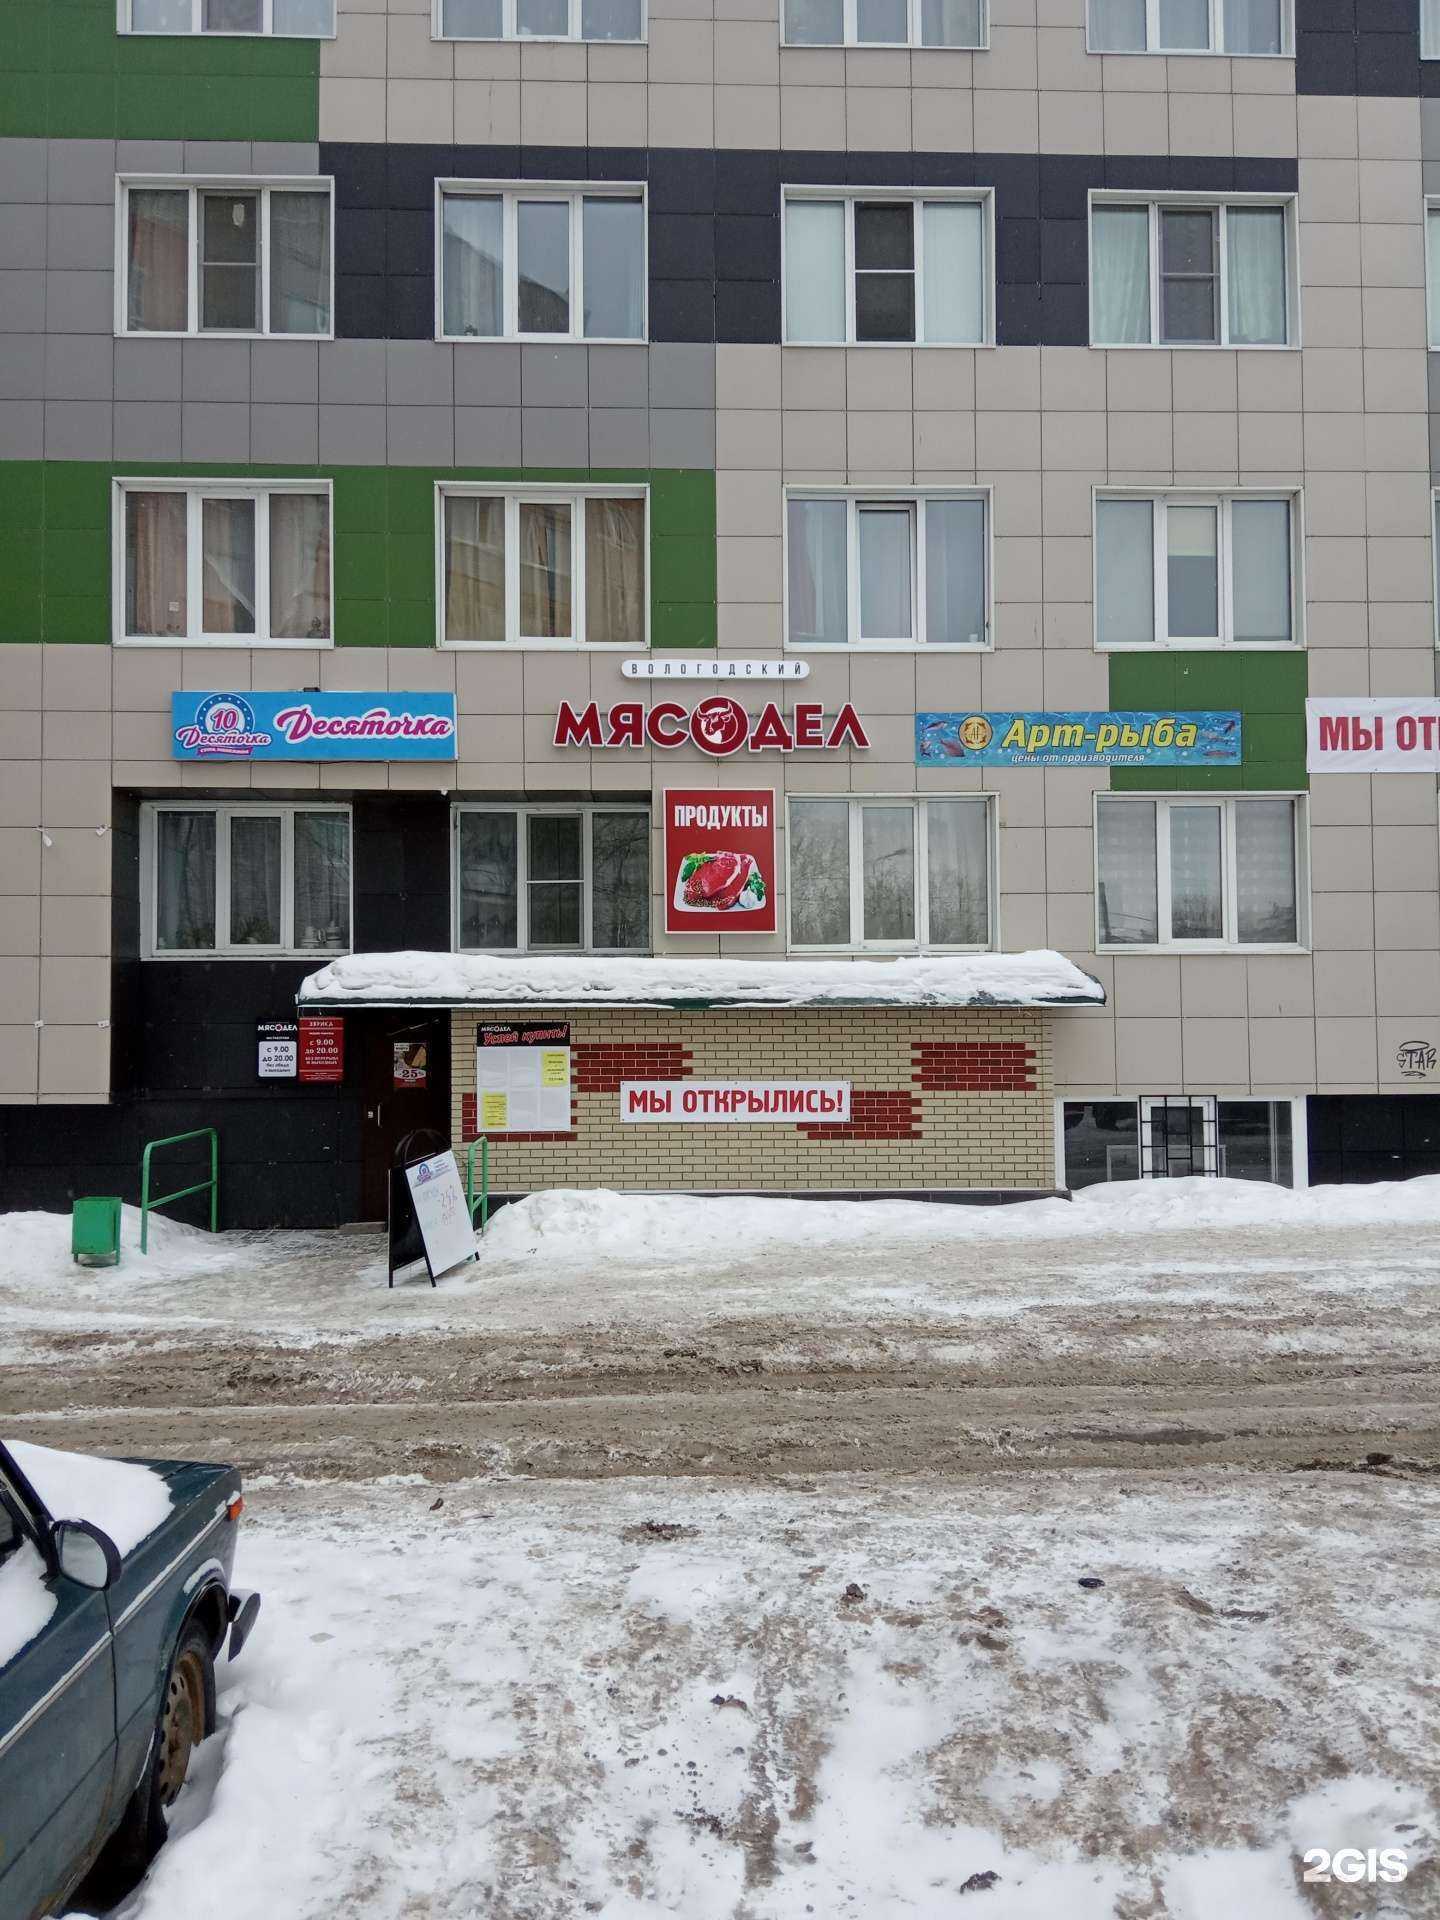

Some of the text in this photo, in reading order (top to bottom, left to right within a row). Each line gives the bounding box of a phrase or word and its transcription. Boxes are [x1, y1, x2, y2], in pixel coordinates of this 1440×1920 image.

[631, 662, 801, 675] ВОЛОГОДСКИЙ
[211, 708, 238, 732] 10
[275, 705, 453, 743] Десяточка
[553, 696, 872, 756] МЯСОДЕЛ
[176, 725, 272, 749] Десяточка
[1001, 717, 1198, 752] Арт-рыба
[1319, 715, 1440, 752] МЫ ОТ
[1011, 753, 1145, 764] цены от производителя
[674, 805, 768, 830] ПРОДУКТЫ
[257, 1023, 298, 1032] МЯСОДЕЛ
[481, 1025, 511, 1033] МЯСОДЕЛ
[629, 1090, 843, 1113] МЫ ОТКРЫЛИСЬ!
